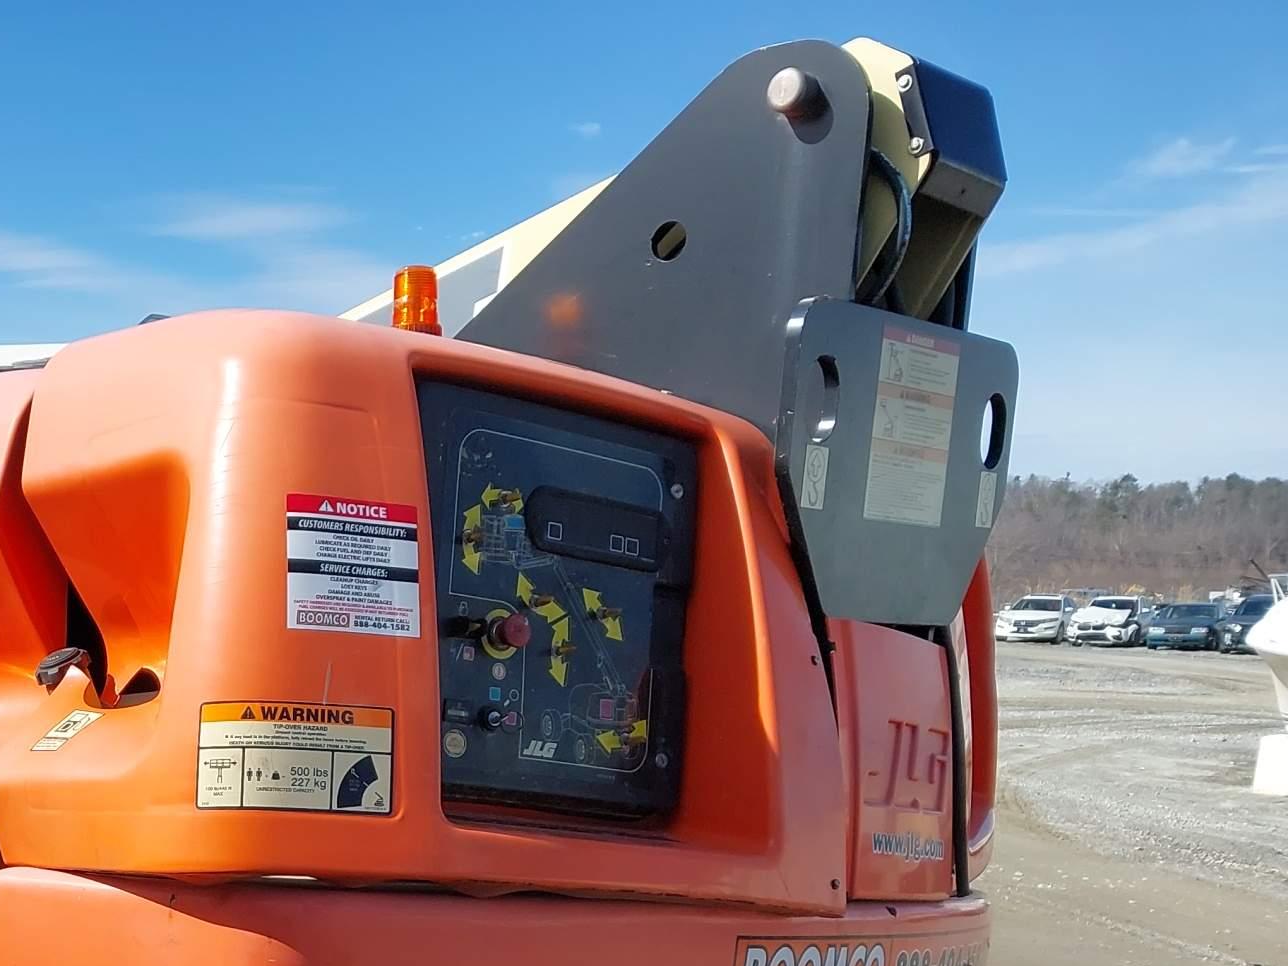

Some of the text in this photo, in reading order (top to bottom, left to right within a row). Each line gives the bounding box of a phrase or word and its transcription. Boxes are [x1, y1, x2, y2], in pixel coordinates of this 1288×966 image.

[336, 502, 387, 518] NOTICE
[298, 519, 407, 537] CUSTOMERS RESPONSIBILITY:
[320, 563, 388, 577] SERVICE CHARGES:
[299, 612, 348, 625] BOOMCO
[354, 620, 410, 631] 888-404-1582
[261, 706, 355, 724] WARNING
[523, 740, 558, 758] JLG
[290, 766, 329, 777] 500 lbs
[864, 720, 949, 815] JLG
[291, 778, 327, 790] 227 kg
[872, 831, 945, 863] www.jlg.com
